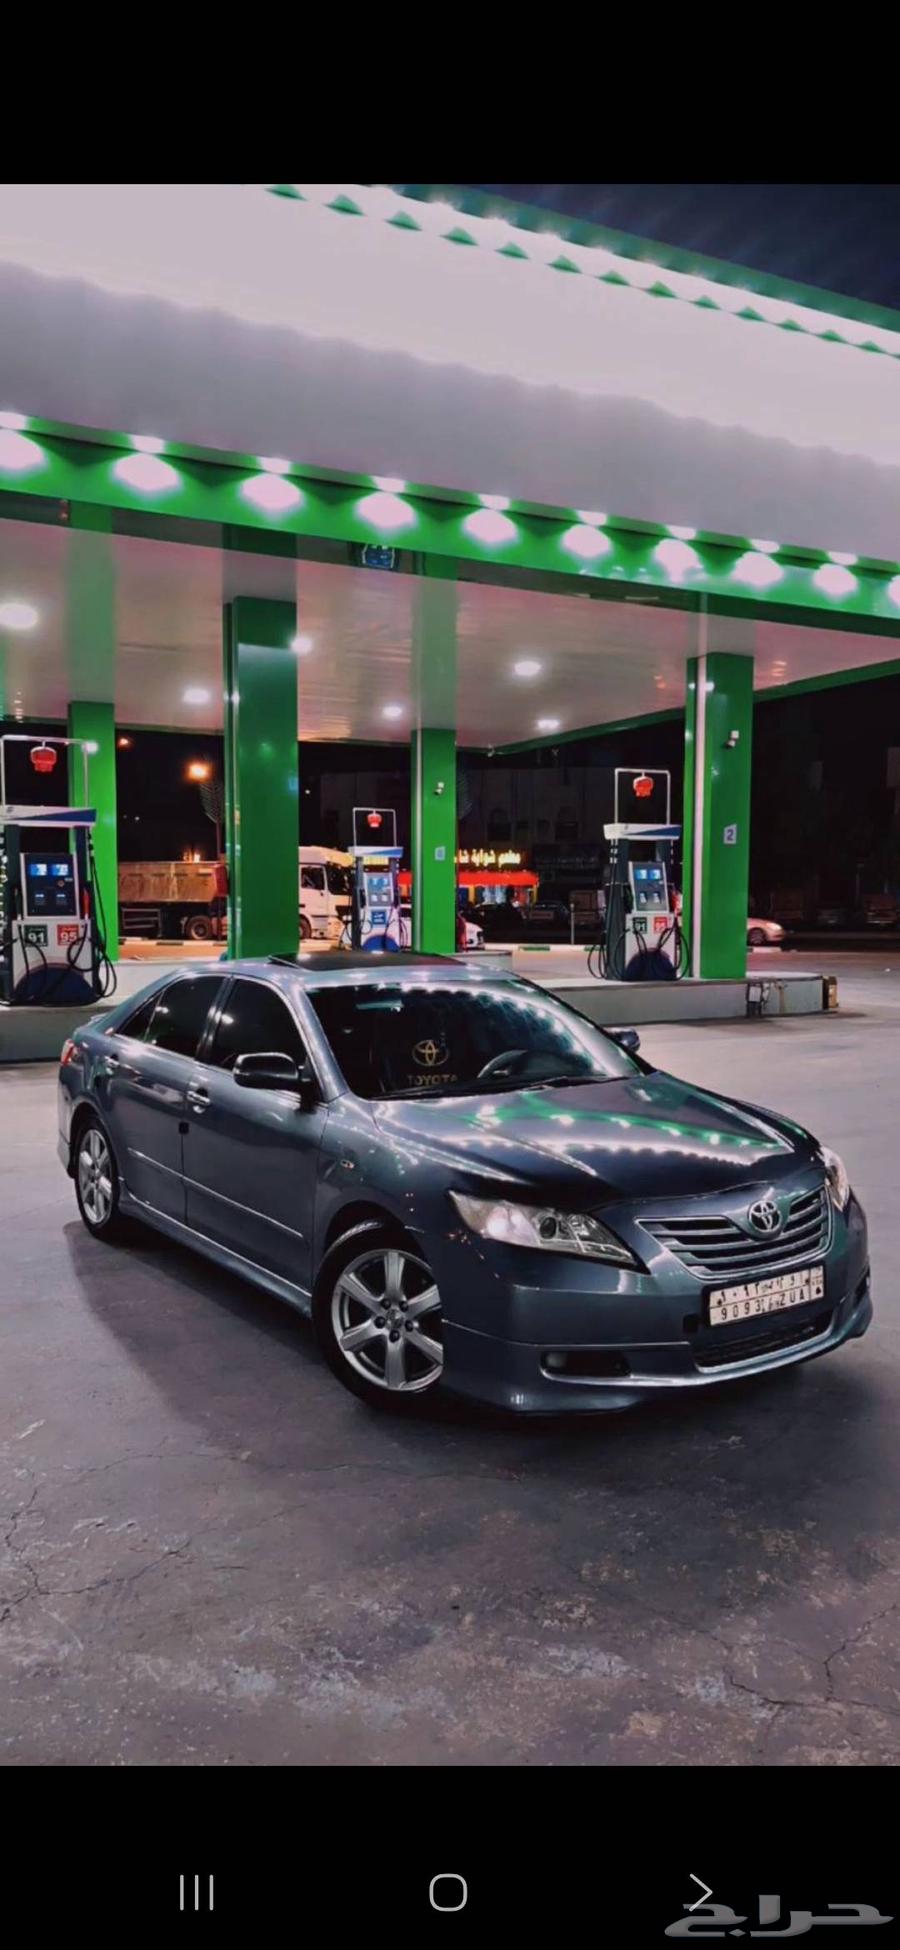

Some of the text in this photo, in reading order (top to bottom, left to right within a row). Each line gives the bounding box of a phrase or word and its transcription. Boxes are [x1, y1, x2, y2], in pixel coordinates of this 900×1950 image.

[726, 828, 734, 841] 2
[498, 849, 521, 868] مطعم
[28, 932, 45, 943] 91
[60, 931, 77, 943] 95
[407, 1074, 458, 1086] TOYOTA
[721, 1299, 761, 1321] 9093
[779, 1287, 805, 1307] ZUA
